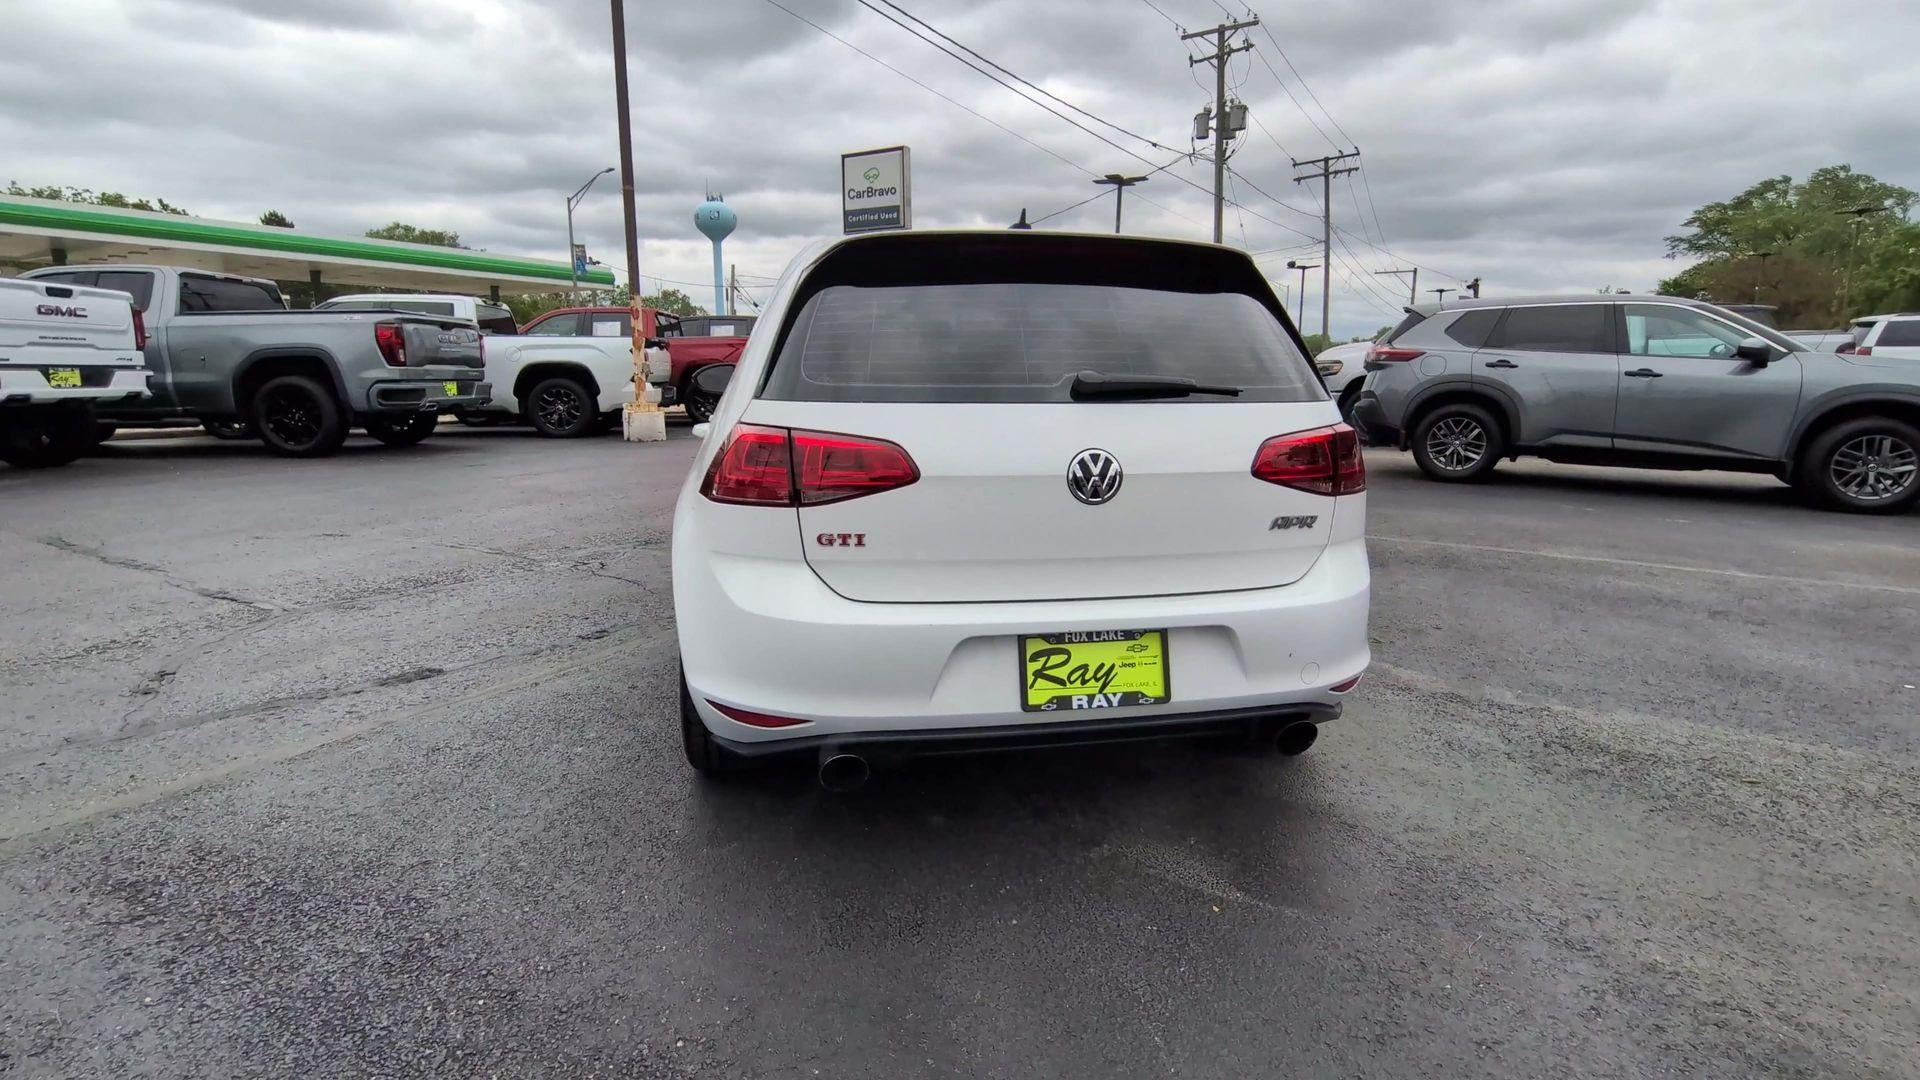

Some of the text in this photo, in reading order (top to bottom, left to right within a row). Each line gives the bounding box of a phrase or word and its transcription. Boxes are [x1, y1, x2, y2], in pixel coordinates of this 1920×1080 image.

[848, 186, 897, 200] CarBravo
[848, 212, 898, 222] Certified Used
[36, 304, 88, 318] GMC
[1268, 515, 1318, 531] APR
[816, 533, 866, 547] GTI
[1064, 630, 1125, 643] FOX LAKE
[1028, 647, 1118, 694] Ray
[1119, 661, 1136, 669] Jeep
[1071, 692, 1124, 709] RAY
